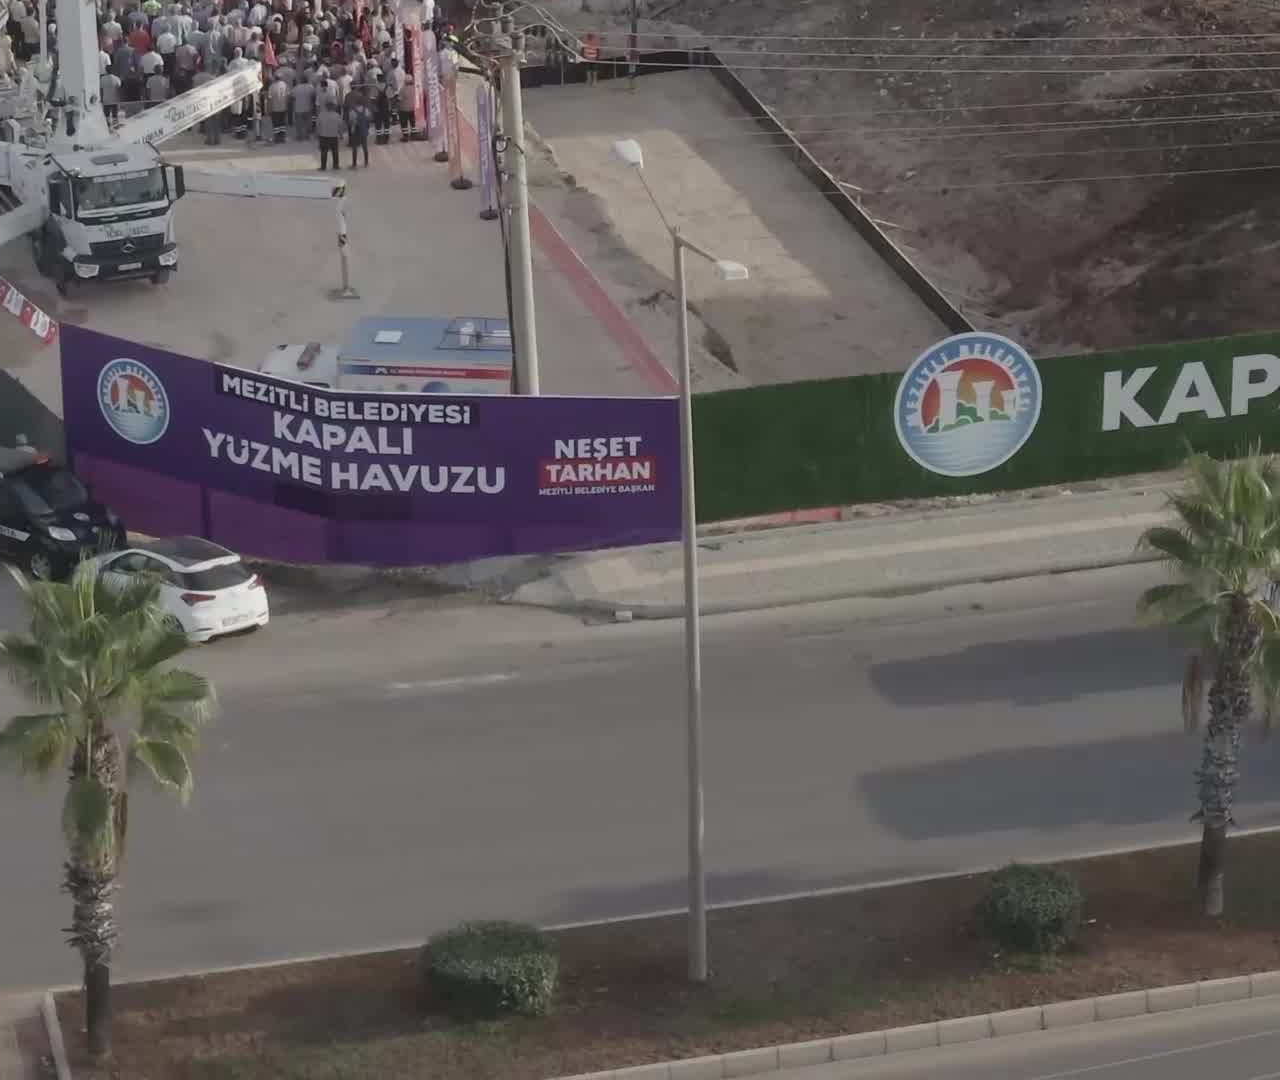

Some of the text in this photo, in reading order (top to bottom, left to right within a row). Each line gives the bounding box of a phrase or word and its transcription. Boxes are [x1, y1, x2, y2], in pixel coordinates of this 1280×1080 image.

[222, 373, 470, 424] MEZİTLİ BELEDİYESİ
[273, 411, 413, 455] KAPALI
[554, 436, 642, 461] NEŞET
[201, 427, 505, 494] YÜZME HAVUZU
[545, 461, 651, 483] TARHAN
